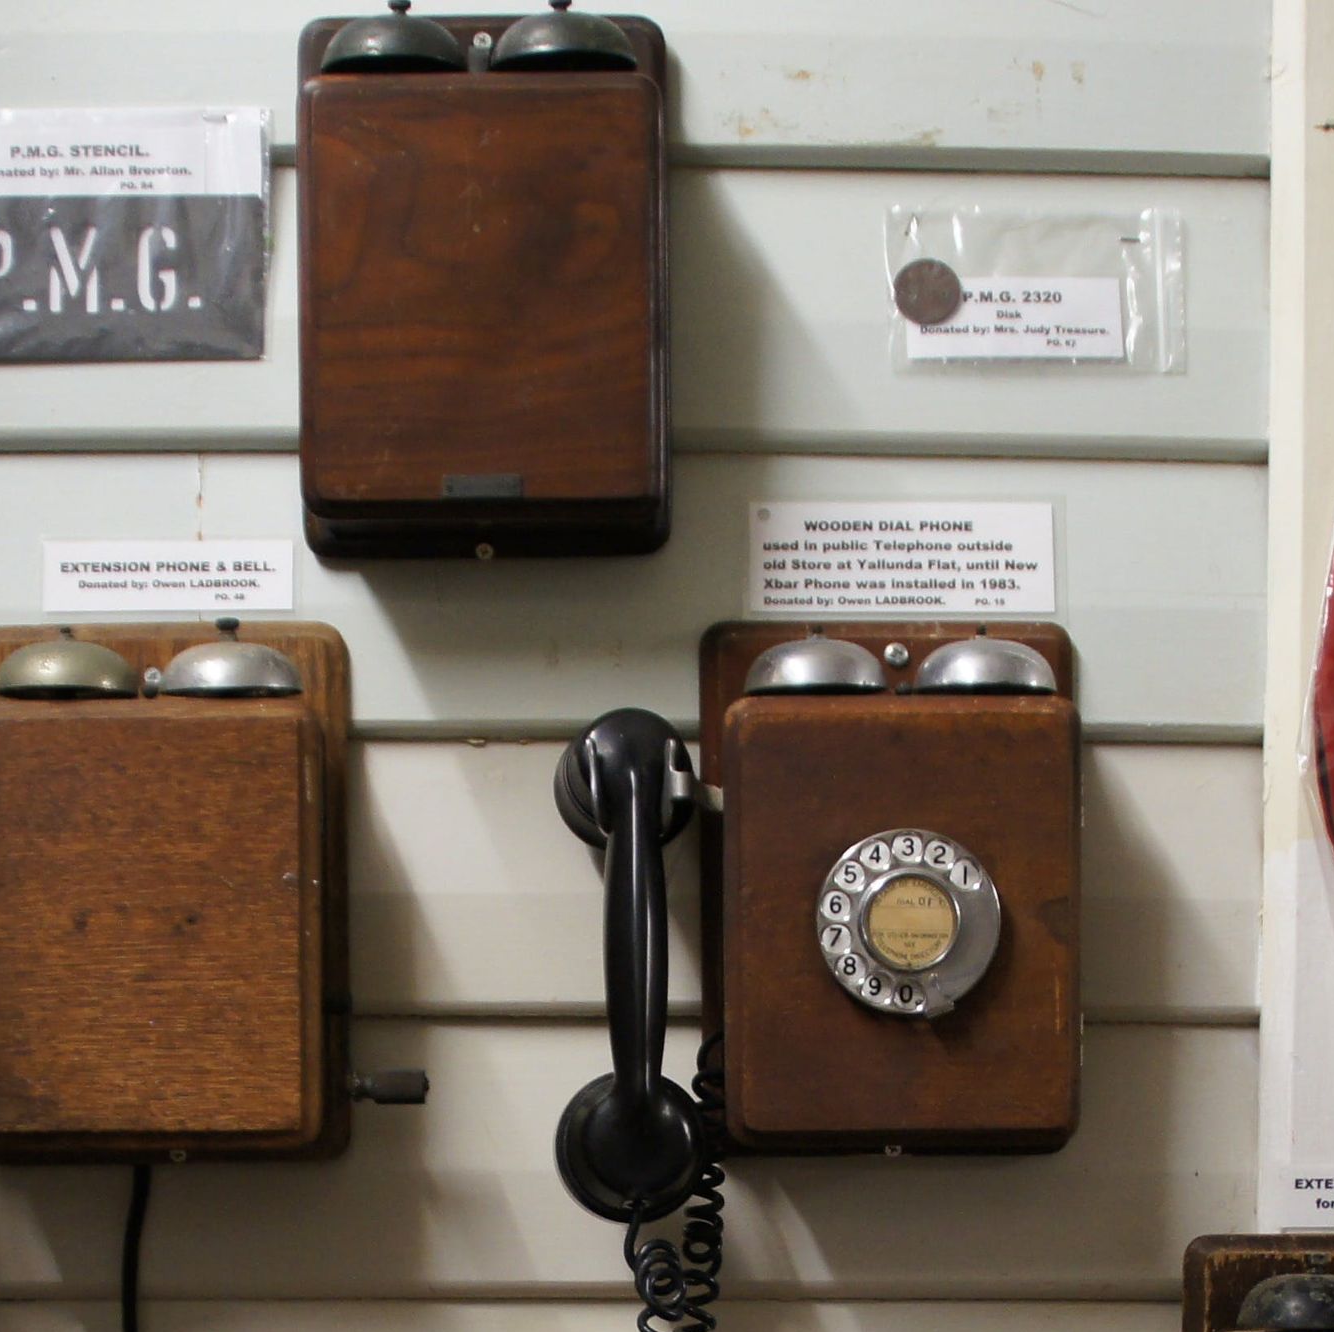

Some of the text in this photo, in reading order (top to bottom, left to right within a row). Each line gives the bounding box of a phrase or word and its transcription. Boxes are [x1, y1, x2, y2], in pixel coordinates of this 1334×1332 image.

[10, 145, 150, 158] P.M.G. STENCIL.
[962, 291, 1062, 302] P.M.G. 2320
[997, 310, 1022, 319] Disk
[804, 520, 973, 532] WOODEN DIAL PHONE
[763, 540, 1013, 553] used in public Telephone outside
[60, 561, 276, 573] EXTENSION PHONE & BELL.
[763, 560, 1038, 572] old Store at Yallunda Flat, until New
[763, 578, 1021, 590] Xbar Phone was installed in 1983.
[830, 838, 967, 1003] 1 2 3 4 5 6 7 8 9 0
